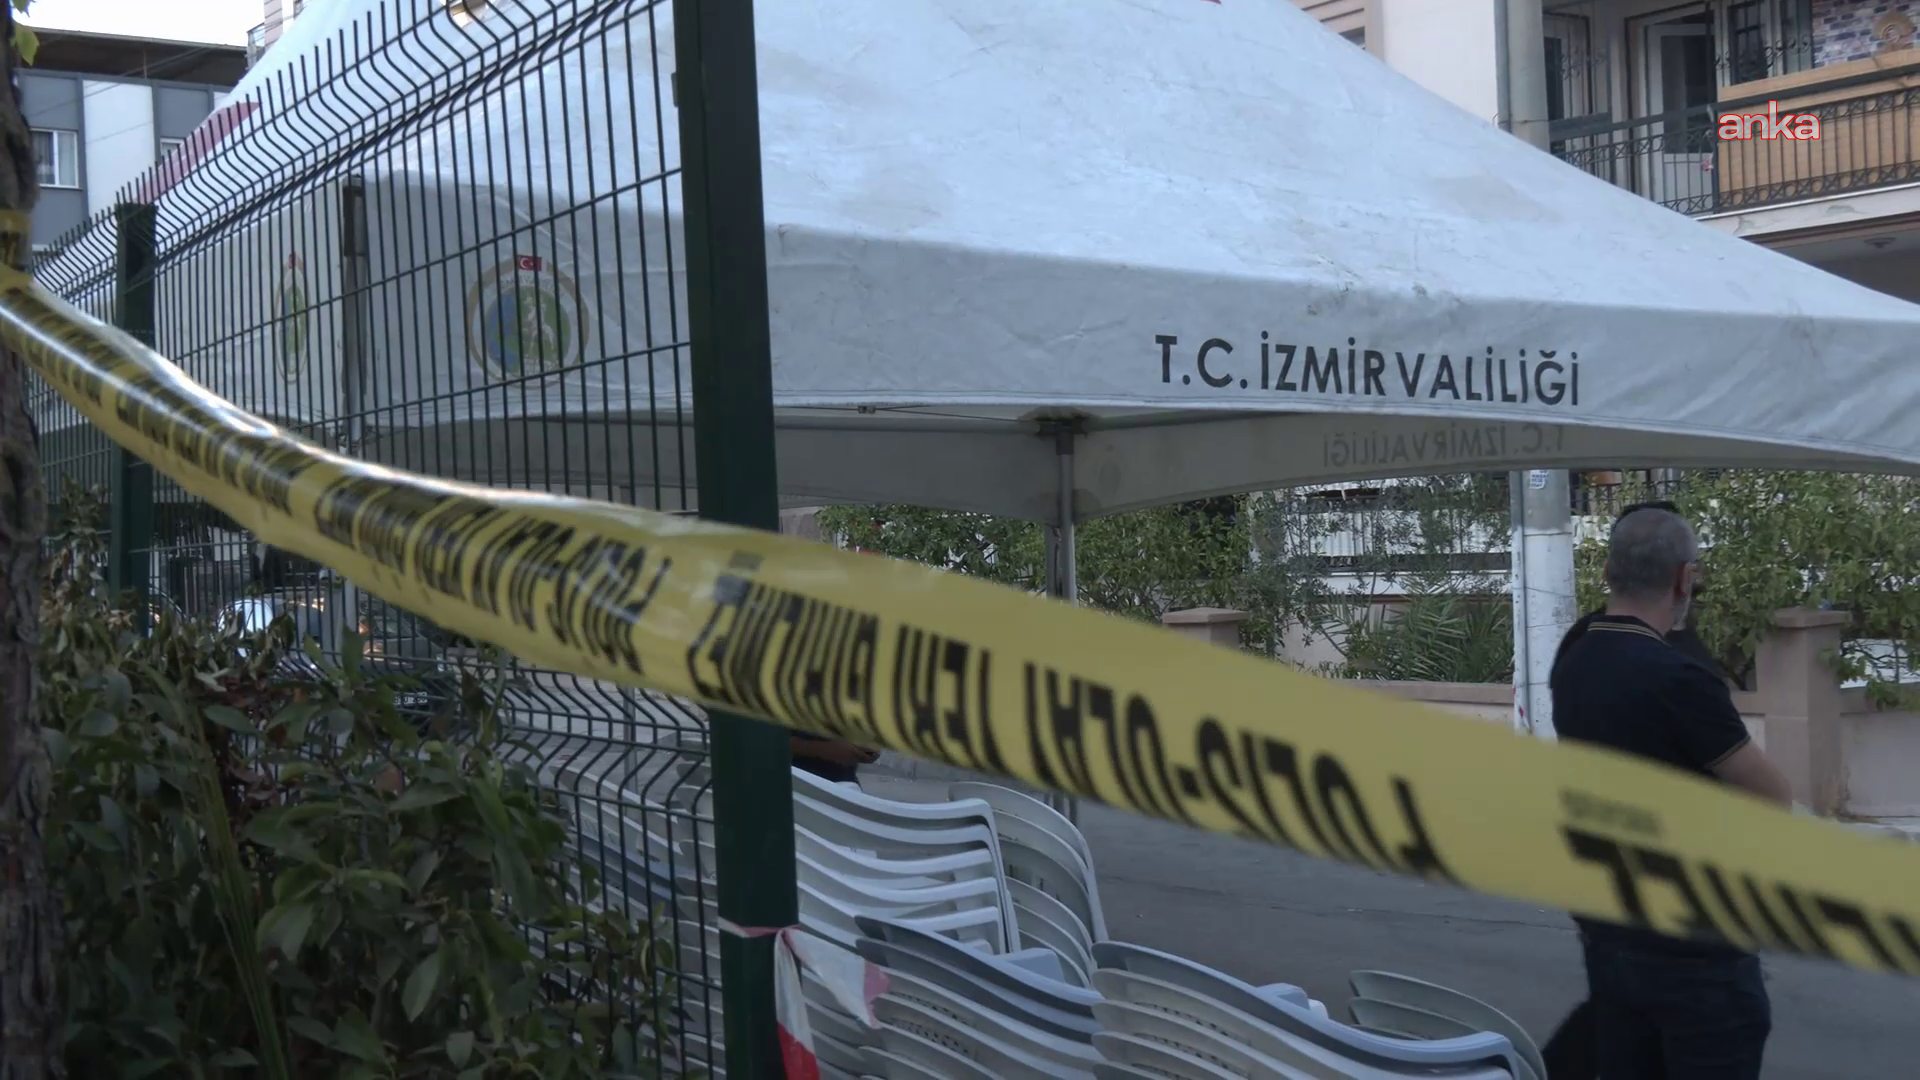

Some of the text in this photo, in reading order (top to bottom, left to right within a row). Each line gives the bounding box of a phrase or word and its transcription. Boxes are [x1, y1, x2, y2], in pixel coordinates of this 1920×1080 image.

[1155, 330, 1579, 407] T.C. İZMİR VALİLİĞİ
